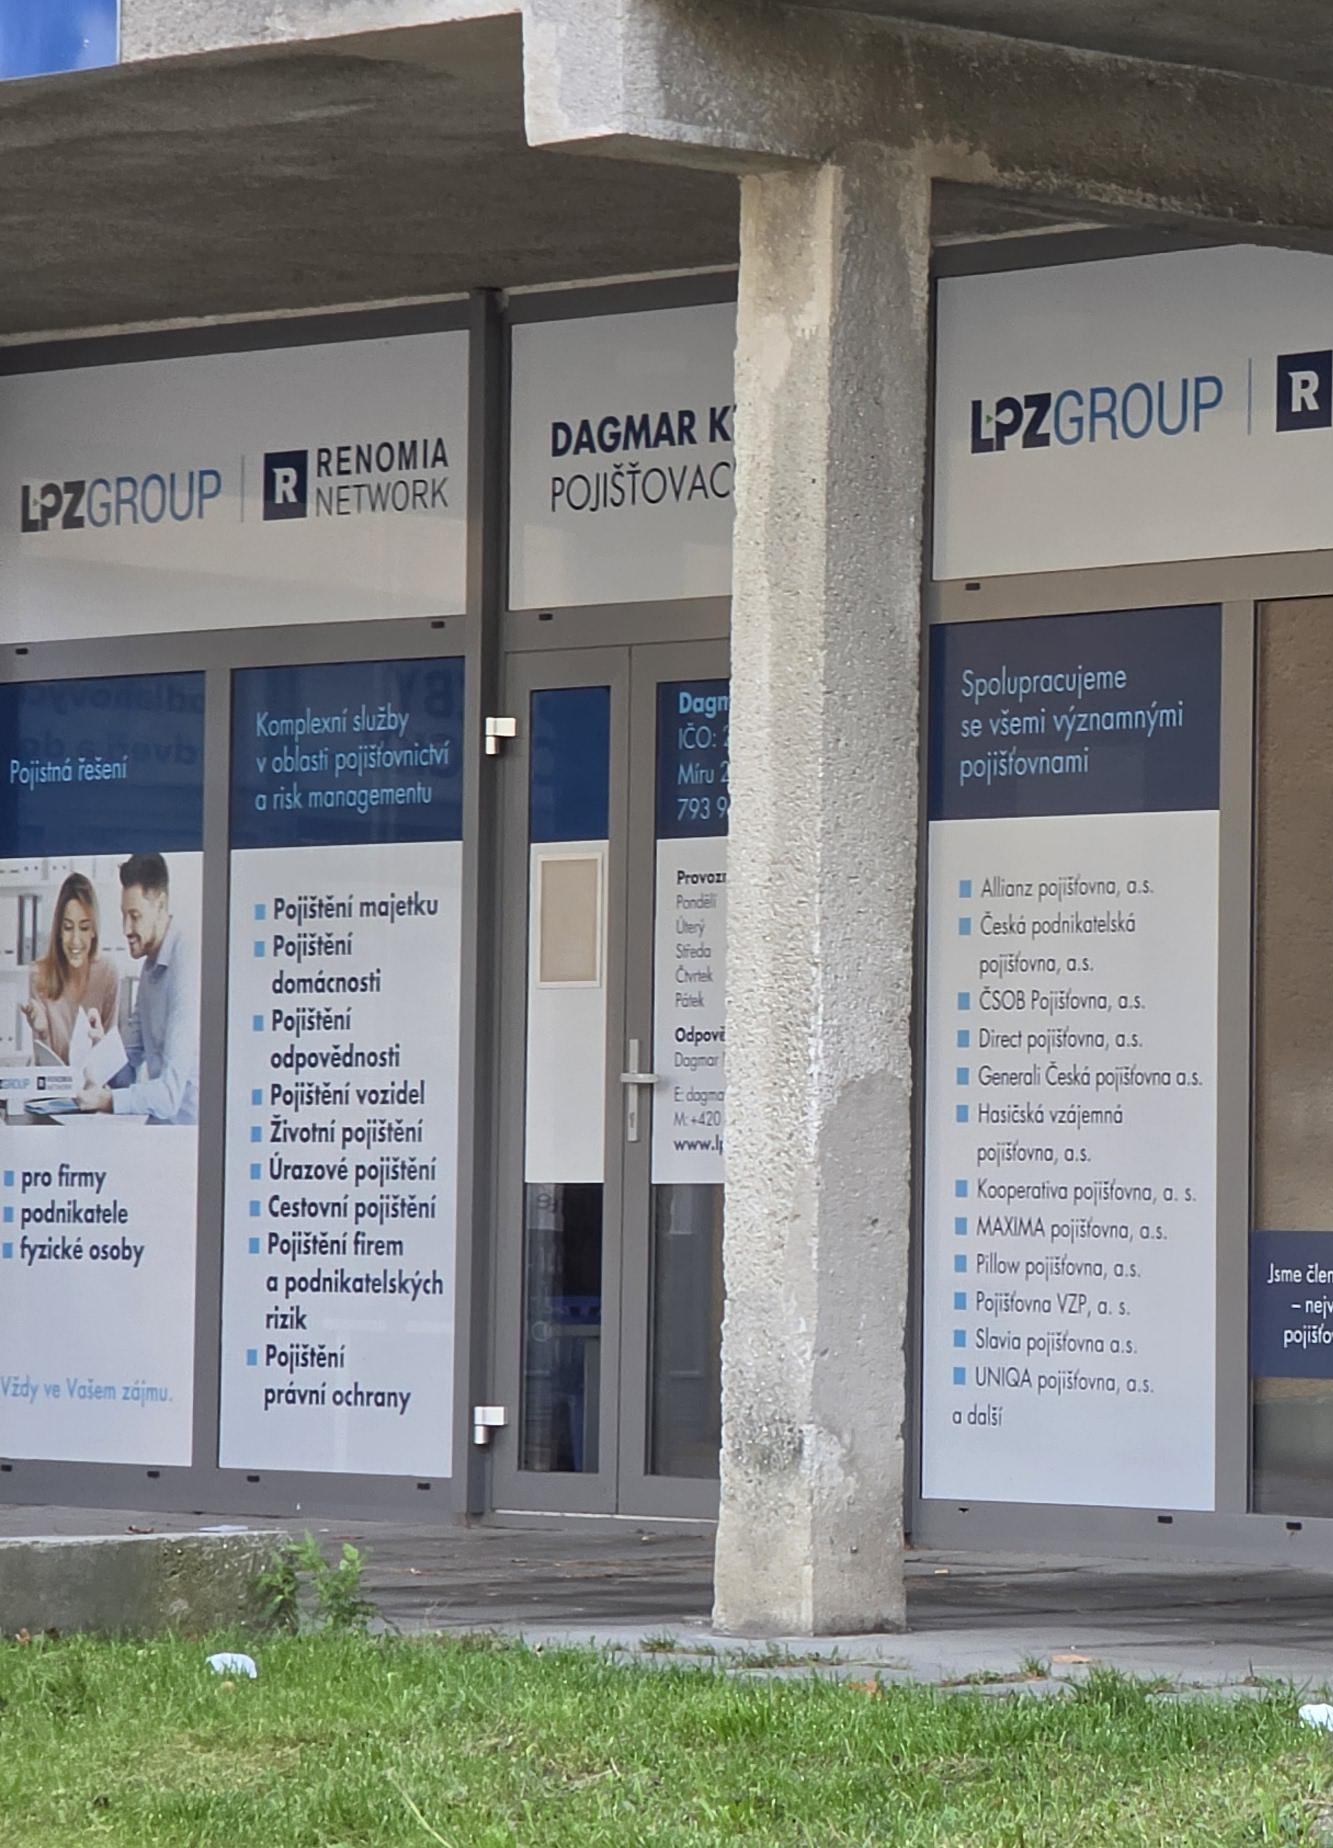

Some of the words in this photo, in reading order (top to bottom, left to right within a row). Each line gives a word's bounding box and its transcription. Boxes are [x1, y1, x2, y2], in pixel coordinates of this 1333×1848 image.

[551, 410, 697, 457] DAGMAR
[709, 404, 738, 442] K
[317, 437, 449, 478] RENOMIA
[315, 475, 449, 517] NETWORK
[551, 461, 736, 512] POJIŠŤOVAC
[961, 666, 1127, 704] Spolupracujeme
[256, 709, 348, 741] Komplexní
[352, 703, 410, 732] služby
[679, 722, 716, 749] IČO:
[961, 716, 982, 738] se
[989, 708, 1046, 736] všemi
[1053, 702, 1184, 739] významnými
[10, 759, 73, 787] Pojistná
[78, 756, 127, 781] řešení
[256, 757, 266, 773] v
[271, 747, 330, 773] oblasti
[334, 743, 449, 771] pojišťovnictví
[960, 749, 1089, 785] pojišťovnami
[678, 763, 715, 784] Míru
[255, 792, 267, 812] a
[272, 787, 304, 811] risk
[308, 782, 432, 813] managementu
[677, 797, 710, 820] 793
[677, 870, 726, 884] Provoz
[981, 876, 1032, 898] Allianz
[1038, 874, 1120, 902] pojišťovna,
[1126, 878, 1154, 894] a.s.
[272, 896, 354, 925] Pojištění
[359, 895, 439, 921] majetku
[980, 911, 1026, 935] Česká
[1031, 910, 1136, 940] podnikatelská
[676, 915, 704, 938] Úterý
[272, 933, 353, 964] Pojištění
[676, 942, 711, 958] Středa
[676, 965, 713, 983] Čtvrtek
[979, 951, 1061, 979] pojišťovna,
[1066, 956, 1094, 972] a.s.
[272, 969, 381, 995] domácnosti
[675, 991, 704, 1007] Pátek
[979, 986, 1025, 1011] ČSOB
[1031, 988, 1113, 1016] Pojišťovna,
[1118, 994, 1146, 1010] a.s.
[271, 1007, 352, 1038] Pojištění
[979, 1028, 1022, 1049] Direct
[1028, 1026, 1109, 1054] pojišťovna,
[1115, 1032, 1143, 1047] a.s.
[270, 1042, 400, 1074] odpovědnosti
[674, 1052, 718, 1071] Dagmar
[978, 1064, 1041, 1086] Generali
[1045, 1061, 1091, 1086] Česká
[1095, 1064, 1171, 1092] pojišťovna
[1176, 1070, 1203, 1086] a.s.
[270, 1082, 351, 1111] Pojištění
[355, 1080, 425, 1106] vozidel
[691, 1111, 721, 1126] +420
[978, 1102, 1044, 1123] Hasičská
[1049, 1104, 1123, 1130] vzájemná
[270, 1115, 335, 1145] Životní
[340, 1118, 423, 1149] pojištění
[268, 1151, 349, 1181] Úrazové
[354, 1156, 437, 1186] pojištění
[977, 1140, 1059, 1167] pojišťovna,
[1064, 1147, 1091, 1162] a.s.
[21, 1168, 53, 1192] pro
[57, 1166, 106, 1194] firmy
[977, 1178, 1067, 1205] Kooperativa
[1073, 1178, 1157, 1206] pojišťovna,
[1163, 1187, 1178, 1200] a.
[1184, 1187, 1196, 1201] s.
[20, 1202, 128, 1231] podnikatele
[267, 1192, 348, 1219] Cestovní
[354, 1193, 436, 1224] pojištění
[976, 1216, 1045, 1237] MAXIMA
[1051, 1217, 1133, 1244] pojišťovna,
[1140, 1225, 1168, 1239] a.s.
[20, 1238, 84, 1267] fyzické
[89, 1238, 144, 1268] osoby
[267, 1232, 348, 1261] Pojištění
[352, 1232, 403, 1256] firem
[976, 1253, 1020, 1274] Pillow
[1025, 1253, 1108, 1281] pojišťovna,
[1114, 1262, 1141, 1277] a.s.
[1267, 1263, 1302, 1284] Jsme
[266, 1272, 279, 1293] a
[284, 1268, 443, 1301] podnikatelských
[265, 1306, 307, 1331] rizik
[976, 1290, 1051, 1317] Pojišťovna
[1057, 1293, 1091, 1318] VZP,
[1098, 1300, 1112, 1315] a.
[1119, 1301, 1130, 1316] s.
[975, 1327, 1021, 1349] Slavia
[1027, 1330, 1104, 1357] pojišťovna
[1110, 1339, 1137, 1354] a.s.
[265, 1344, 346, 1374] Pojištění
[0, 1374, 38, 1404] Vždy
[44, 1383, 60, 1398] ve
[66, 1377, 116, 1400] Vašem
[122, 1380, 172, 1407] zájmu.
[975, 1366, 1032, 1388] UNIQA
[1037, 1369, 1120, 1396] pojišťovna,
[1126, 1377, 1154, 1393] a.s.
[264, 1383, 327, 1412] právní
[331, 1383, 411, 1415] ochrany
[952, 1411, 962, 1425] a
[967, 1404, 1003, 1426] další
